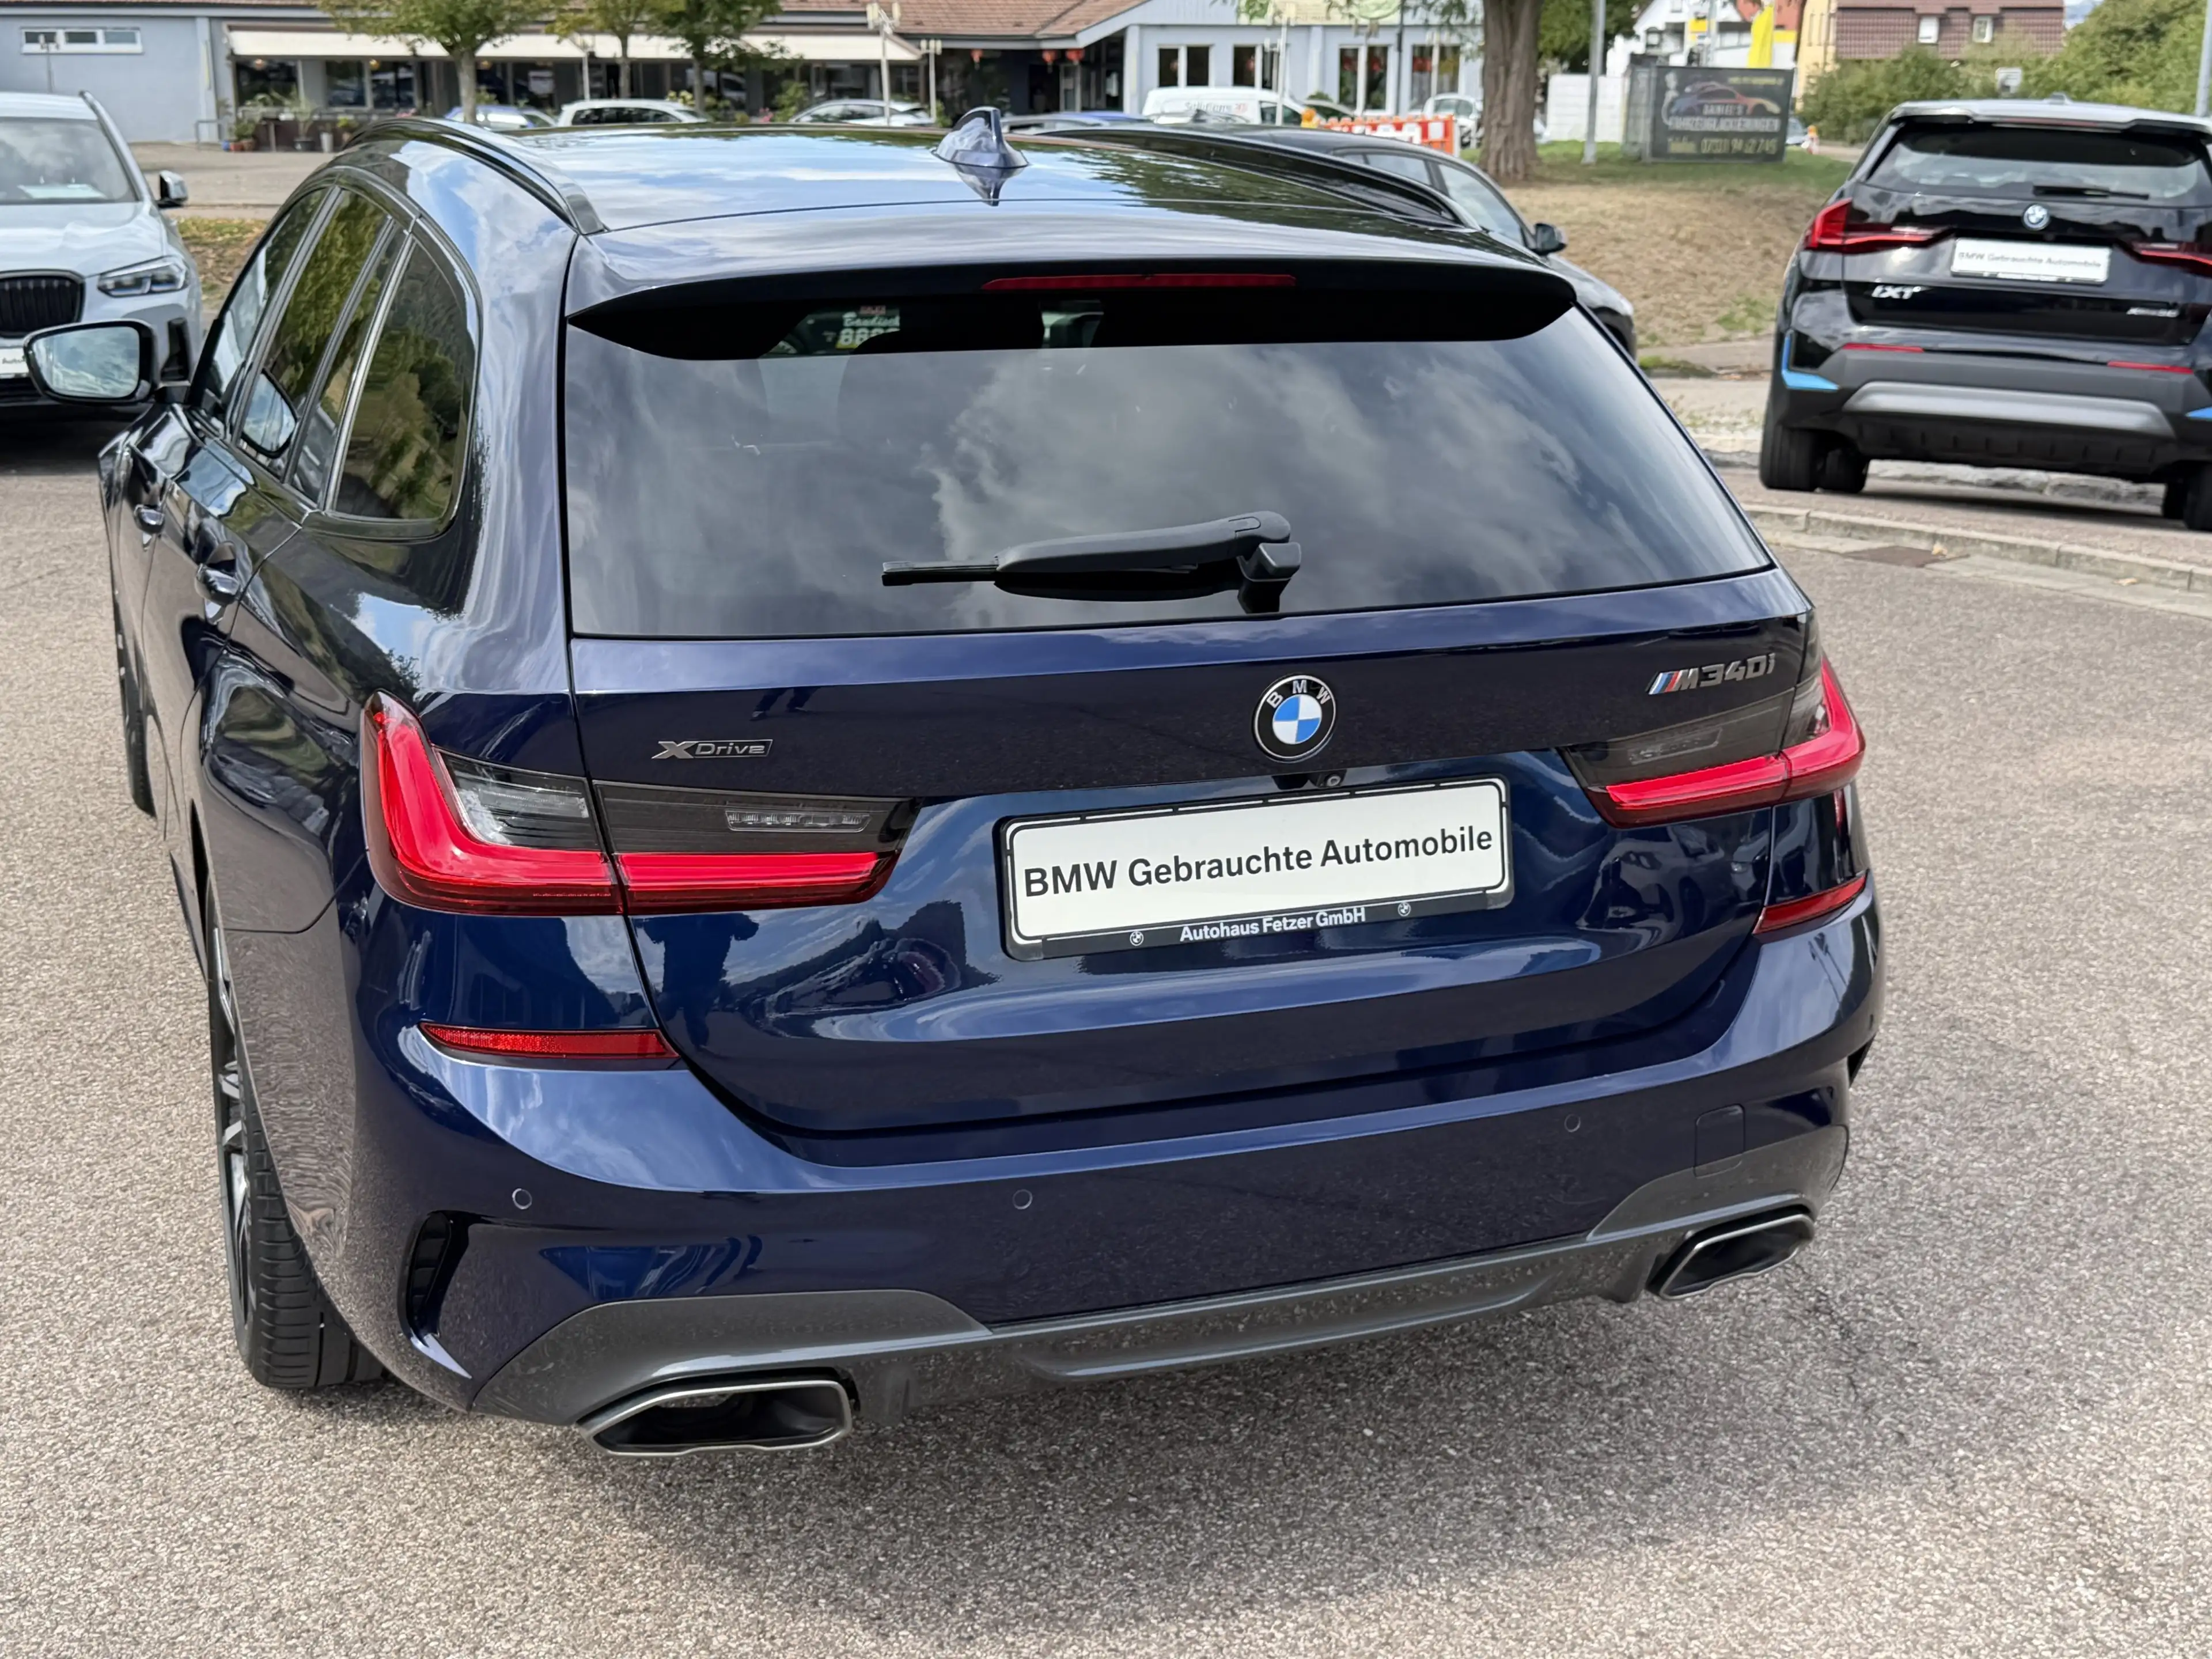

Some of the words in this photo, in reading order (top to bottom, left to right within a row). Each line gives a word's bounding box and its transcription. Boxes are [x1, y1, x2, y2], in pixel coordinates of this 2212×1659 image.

[1959, 252, 1985, 260] BMW
[1649, 653, 1775, 695] M340i
[1267, 679, 1331, 709] BMW
[1024, 860, 1118, 897] BMW
[1128, 846, 1312, 887] Gebrauchte
[1320, 825, 1493, 867] Automobile
[1180, 922, 1260, 941] Autohaus
[1262, 916, 1314, 933] Fetzer
[1316, 907, 1366, 927] GmbH
